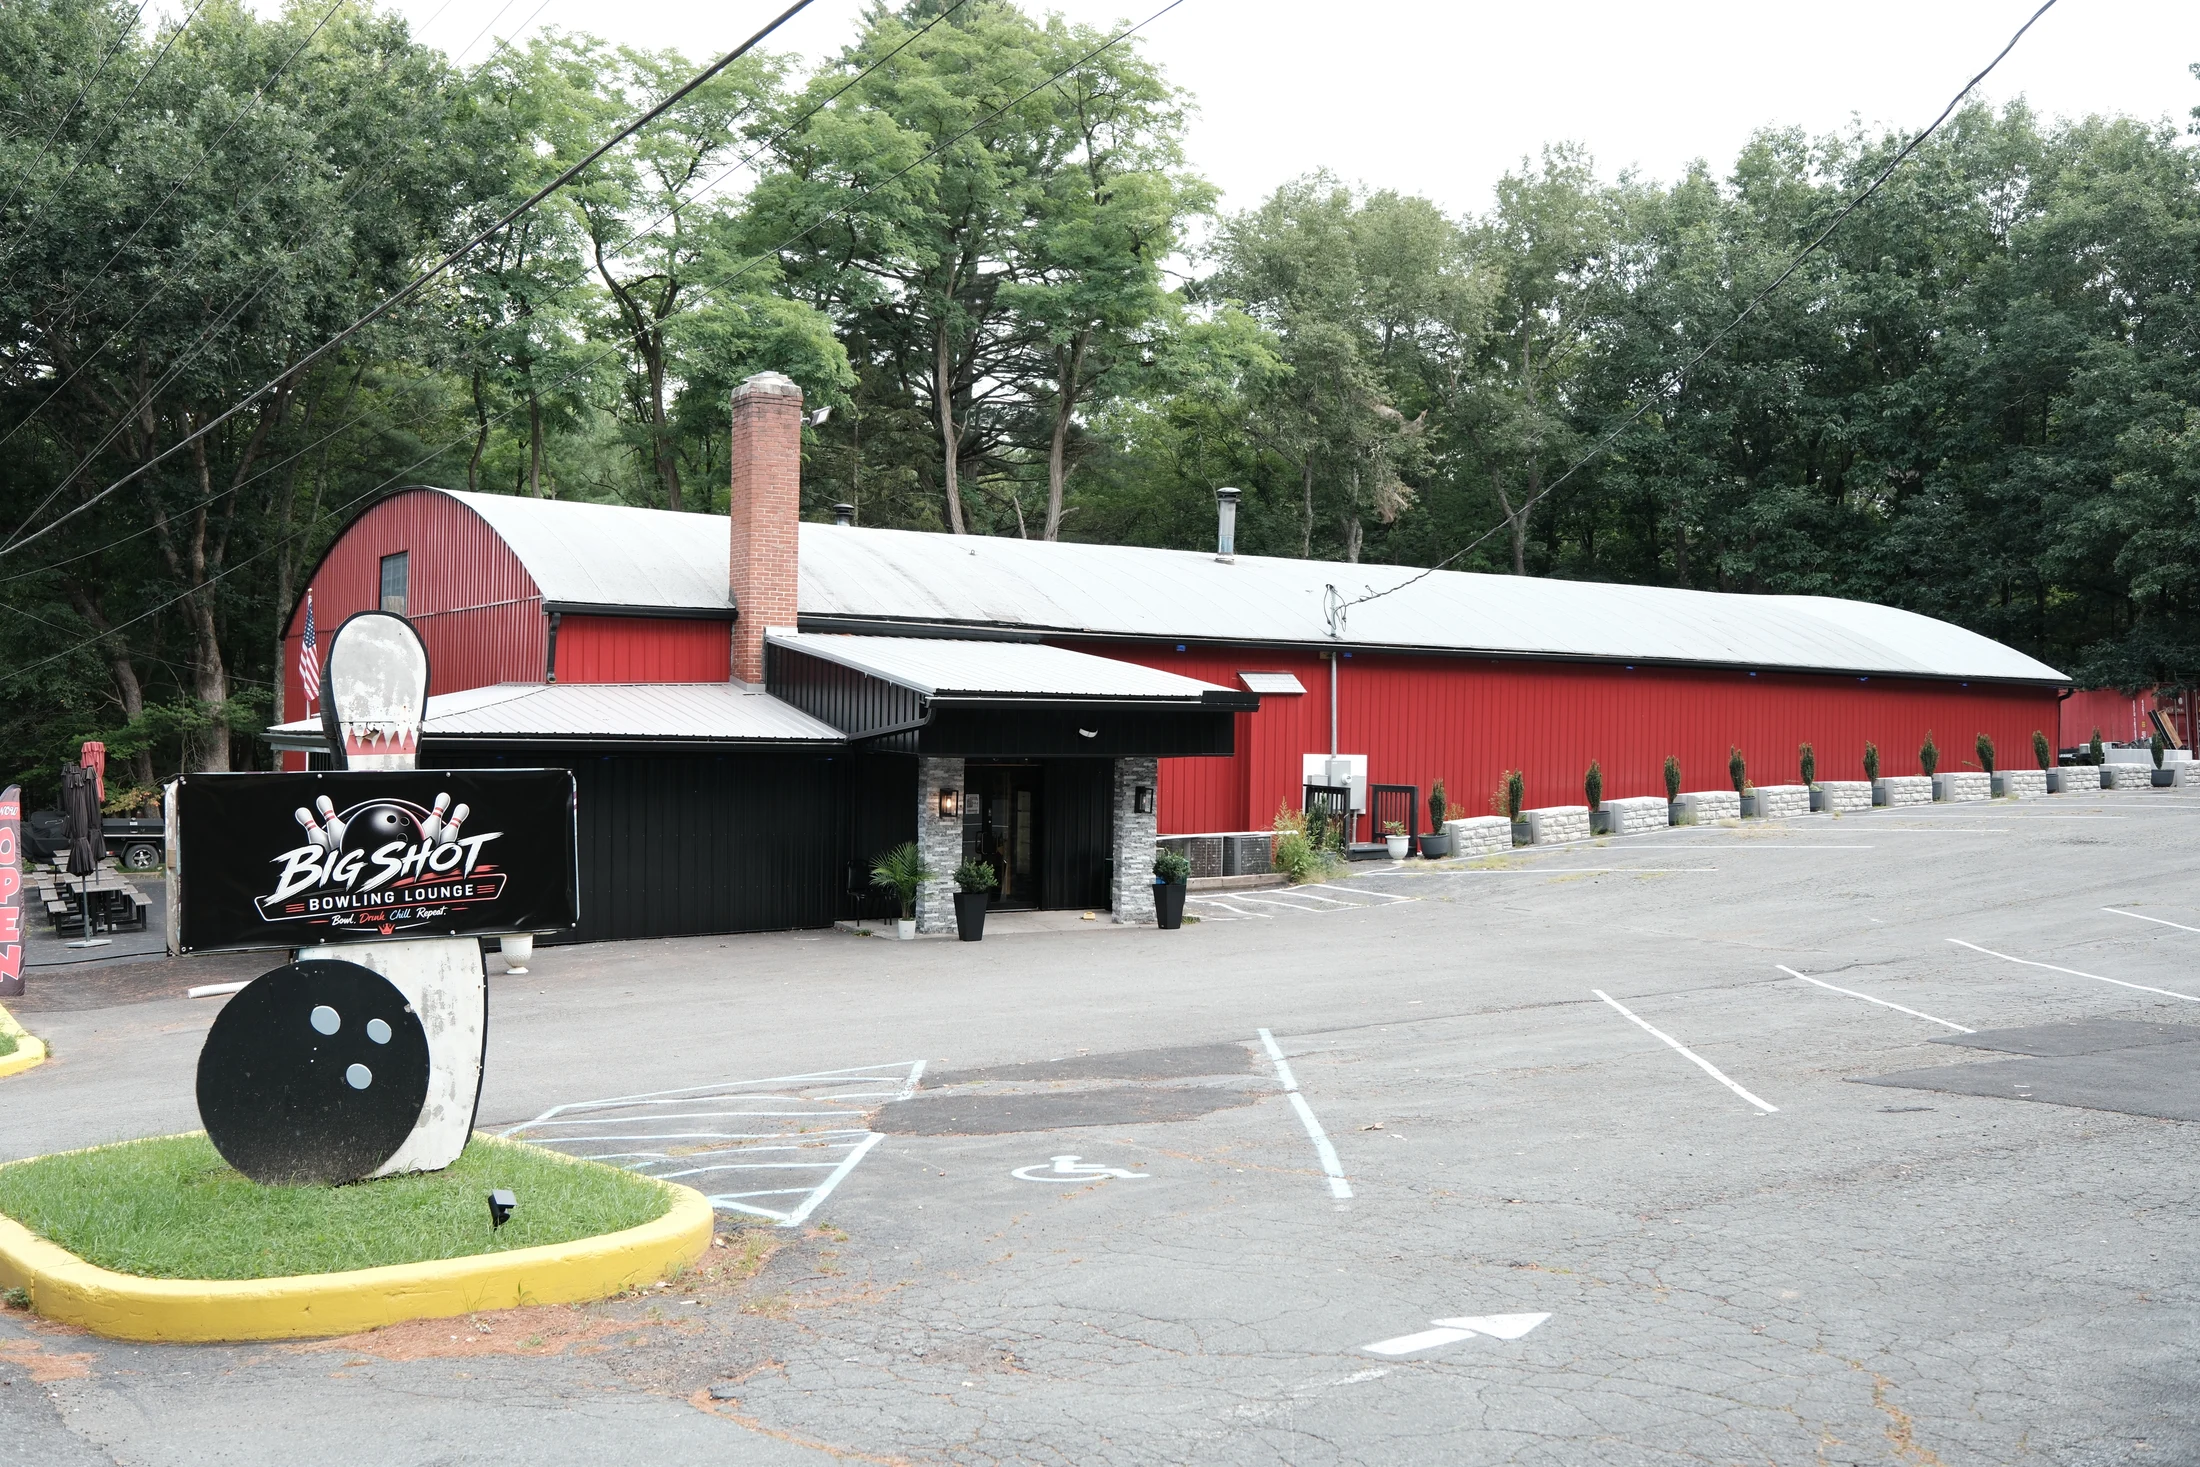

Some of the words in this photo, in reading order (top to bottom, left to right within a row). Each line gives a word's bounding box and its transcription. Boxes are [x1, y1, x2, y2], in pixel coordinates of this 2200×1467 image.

[0, 826, 21, 983] OPEN
[263, 844, 368, 907] BIG
[356, 832, 504, 893] SHOT
[309, 892, 395, 911] BOWLING
[404, 884, 474, 902] LOUNGE
